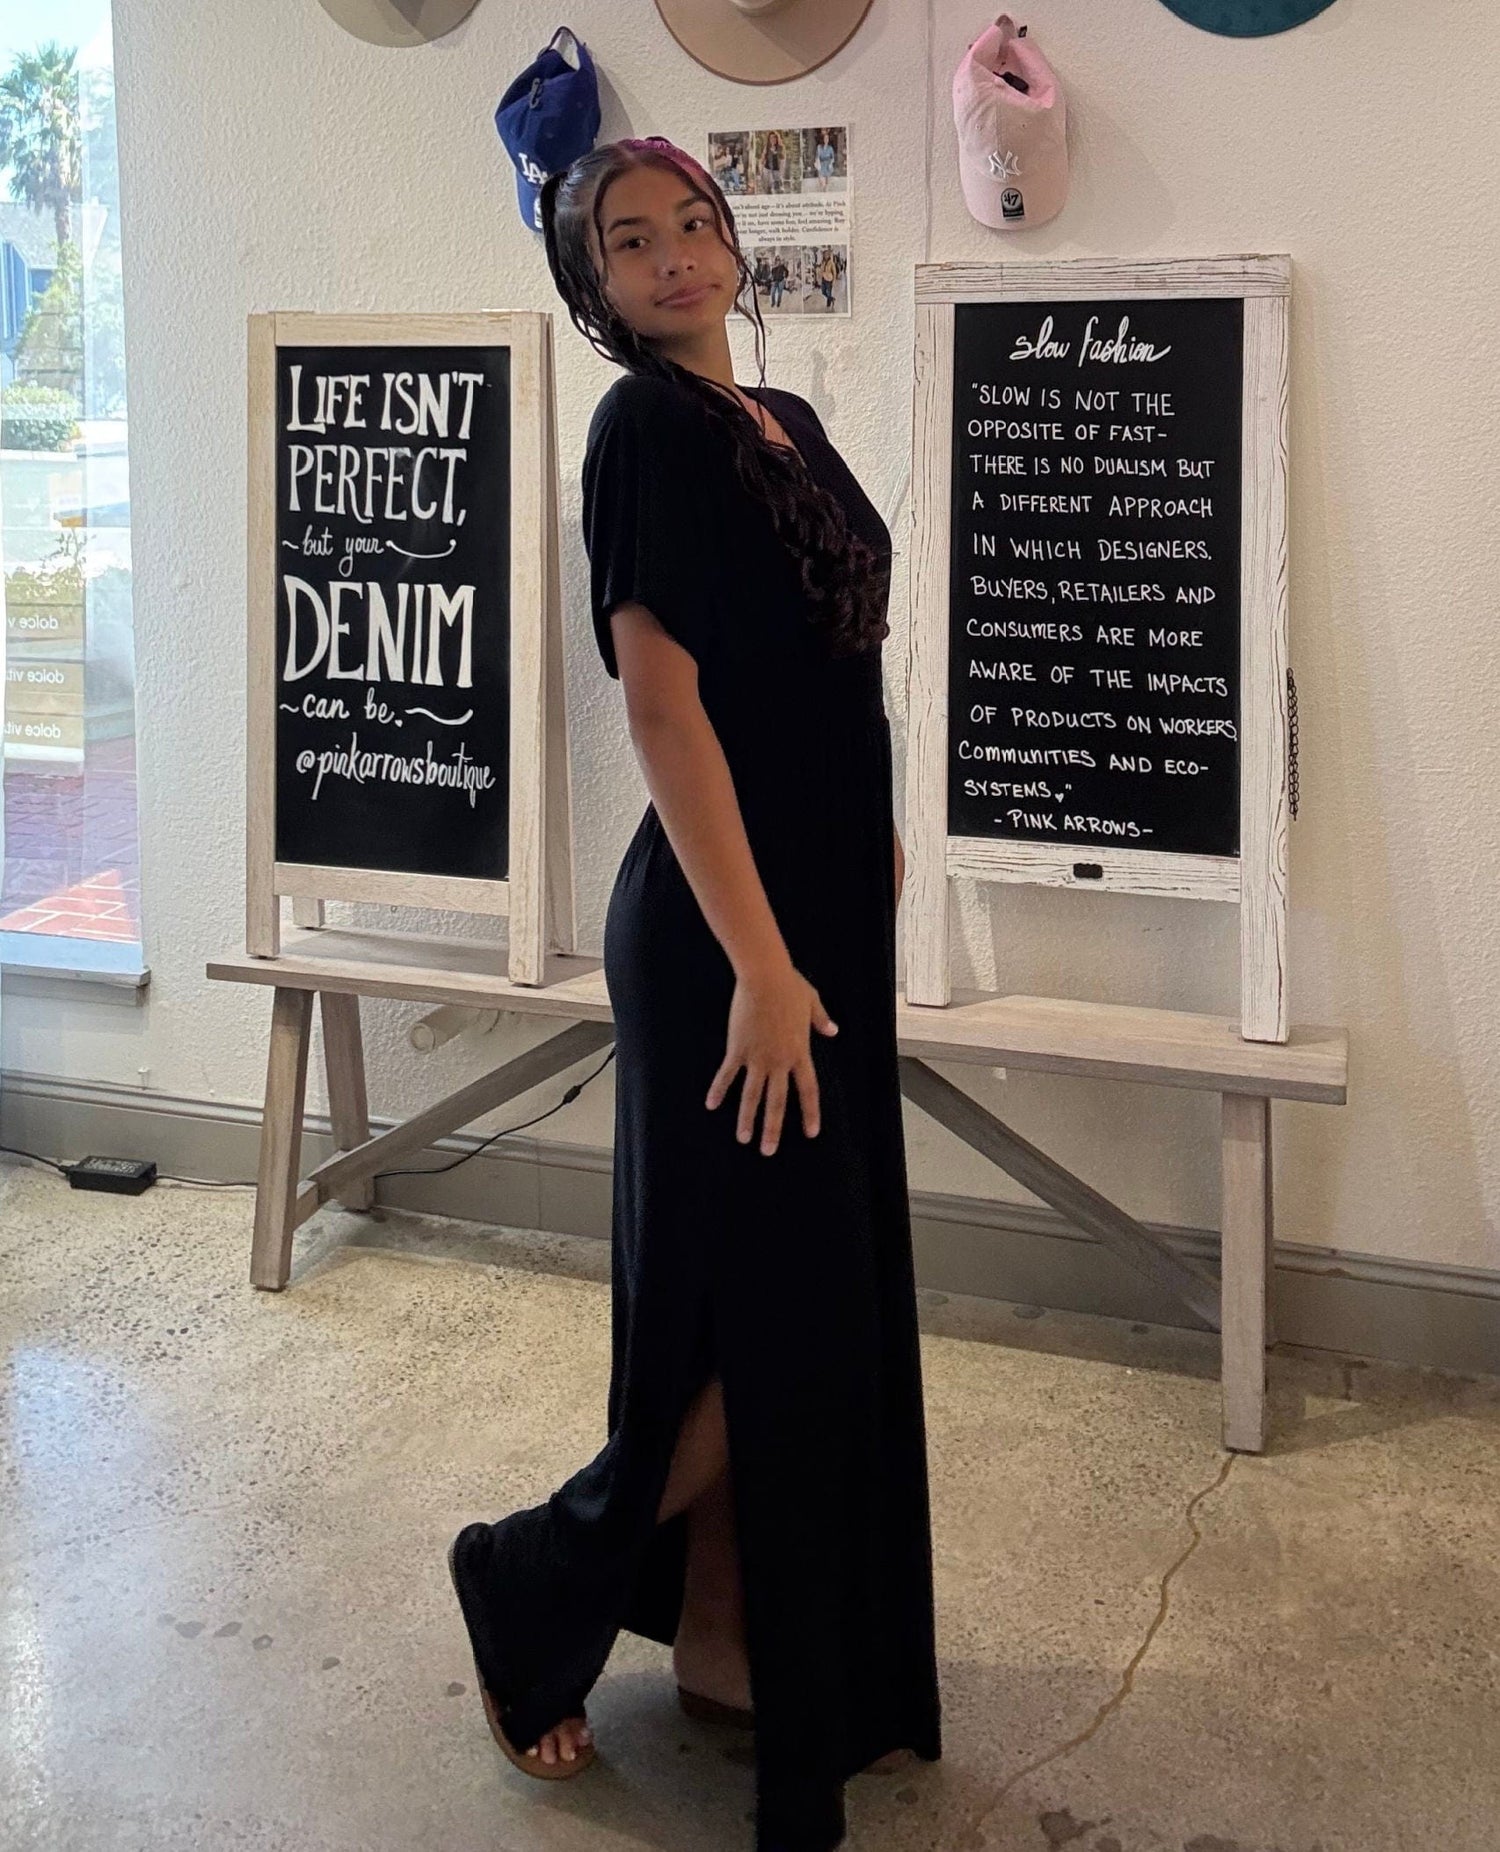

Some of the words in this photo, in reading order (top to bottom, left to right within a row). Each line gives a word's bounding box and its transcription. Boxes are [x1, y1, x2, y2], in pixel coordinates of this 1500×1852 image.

[1078, 316, 1171, 367] fashion
[287, 364, 370, 434] LIFE
[379, 371, 484, 440] ISN'T
[1041, 388, 1061, 410] IS
[1075, 390, 1120, 411] NOT
[1132, 392, 1175, 416] THE
[968, 419, 1064, 440] OPPOSITE
[1075, 424, 1100, 440] OF
[970, 454, 1027, 476] THERE
[1035, 457, 1050, 475] IS
[1061, 457, 1084, 474] NO
[1094, 456, 1167, 478] DUALISM
[1177, 458, 1215, 478] BUT
[288, 444, 467, 527] PERFECT,
[972, 491, 984, 510] A
[1000, 494, 1092, 514] DIFFERENT
[1109, 497, 1212, 518] APPROACH
[303, 525, 333, 557] but
[339, 536, 385, 577] your
[974, 533, 995, 556] IN
[1010, 538, 1082, 560] WHICH
[1058, 580, 1166, 602] RETAILERS
[1176, 586, 1216, 604] AND
[282, 573, 476, 689] DENIM
[1096, 628, 1135, 646] ARE
[1150, 628, 1203, 648] MORE
[969, 660, 1036, 682] AWARE
[1051, 666, 1074, 684] OF
[1090, 670, 1133, 688] THE
[1148, 673, 1228, 696] IMPACTS
[302, 693, 350, 720] can
[970, 704, 998, 724] OF
[1011, 708, 1117, 728] PRODUCTS
[1127, 716, 1151, 734] ON
[295, 732, 496, 808] @pinkarrowsboutique
[1109, 754, 1152, 773] AND
